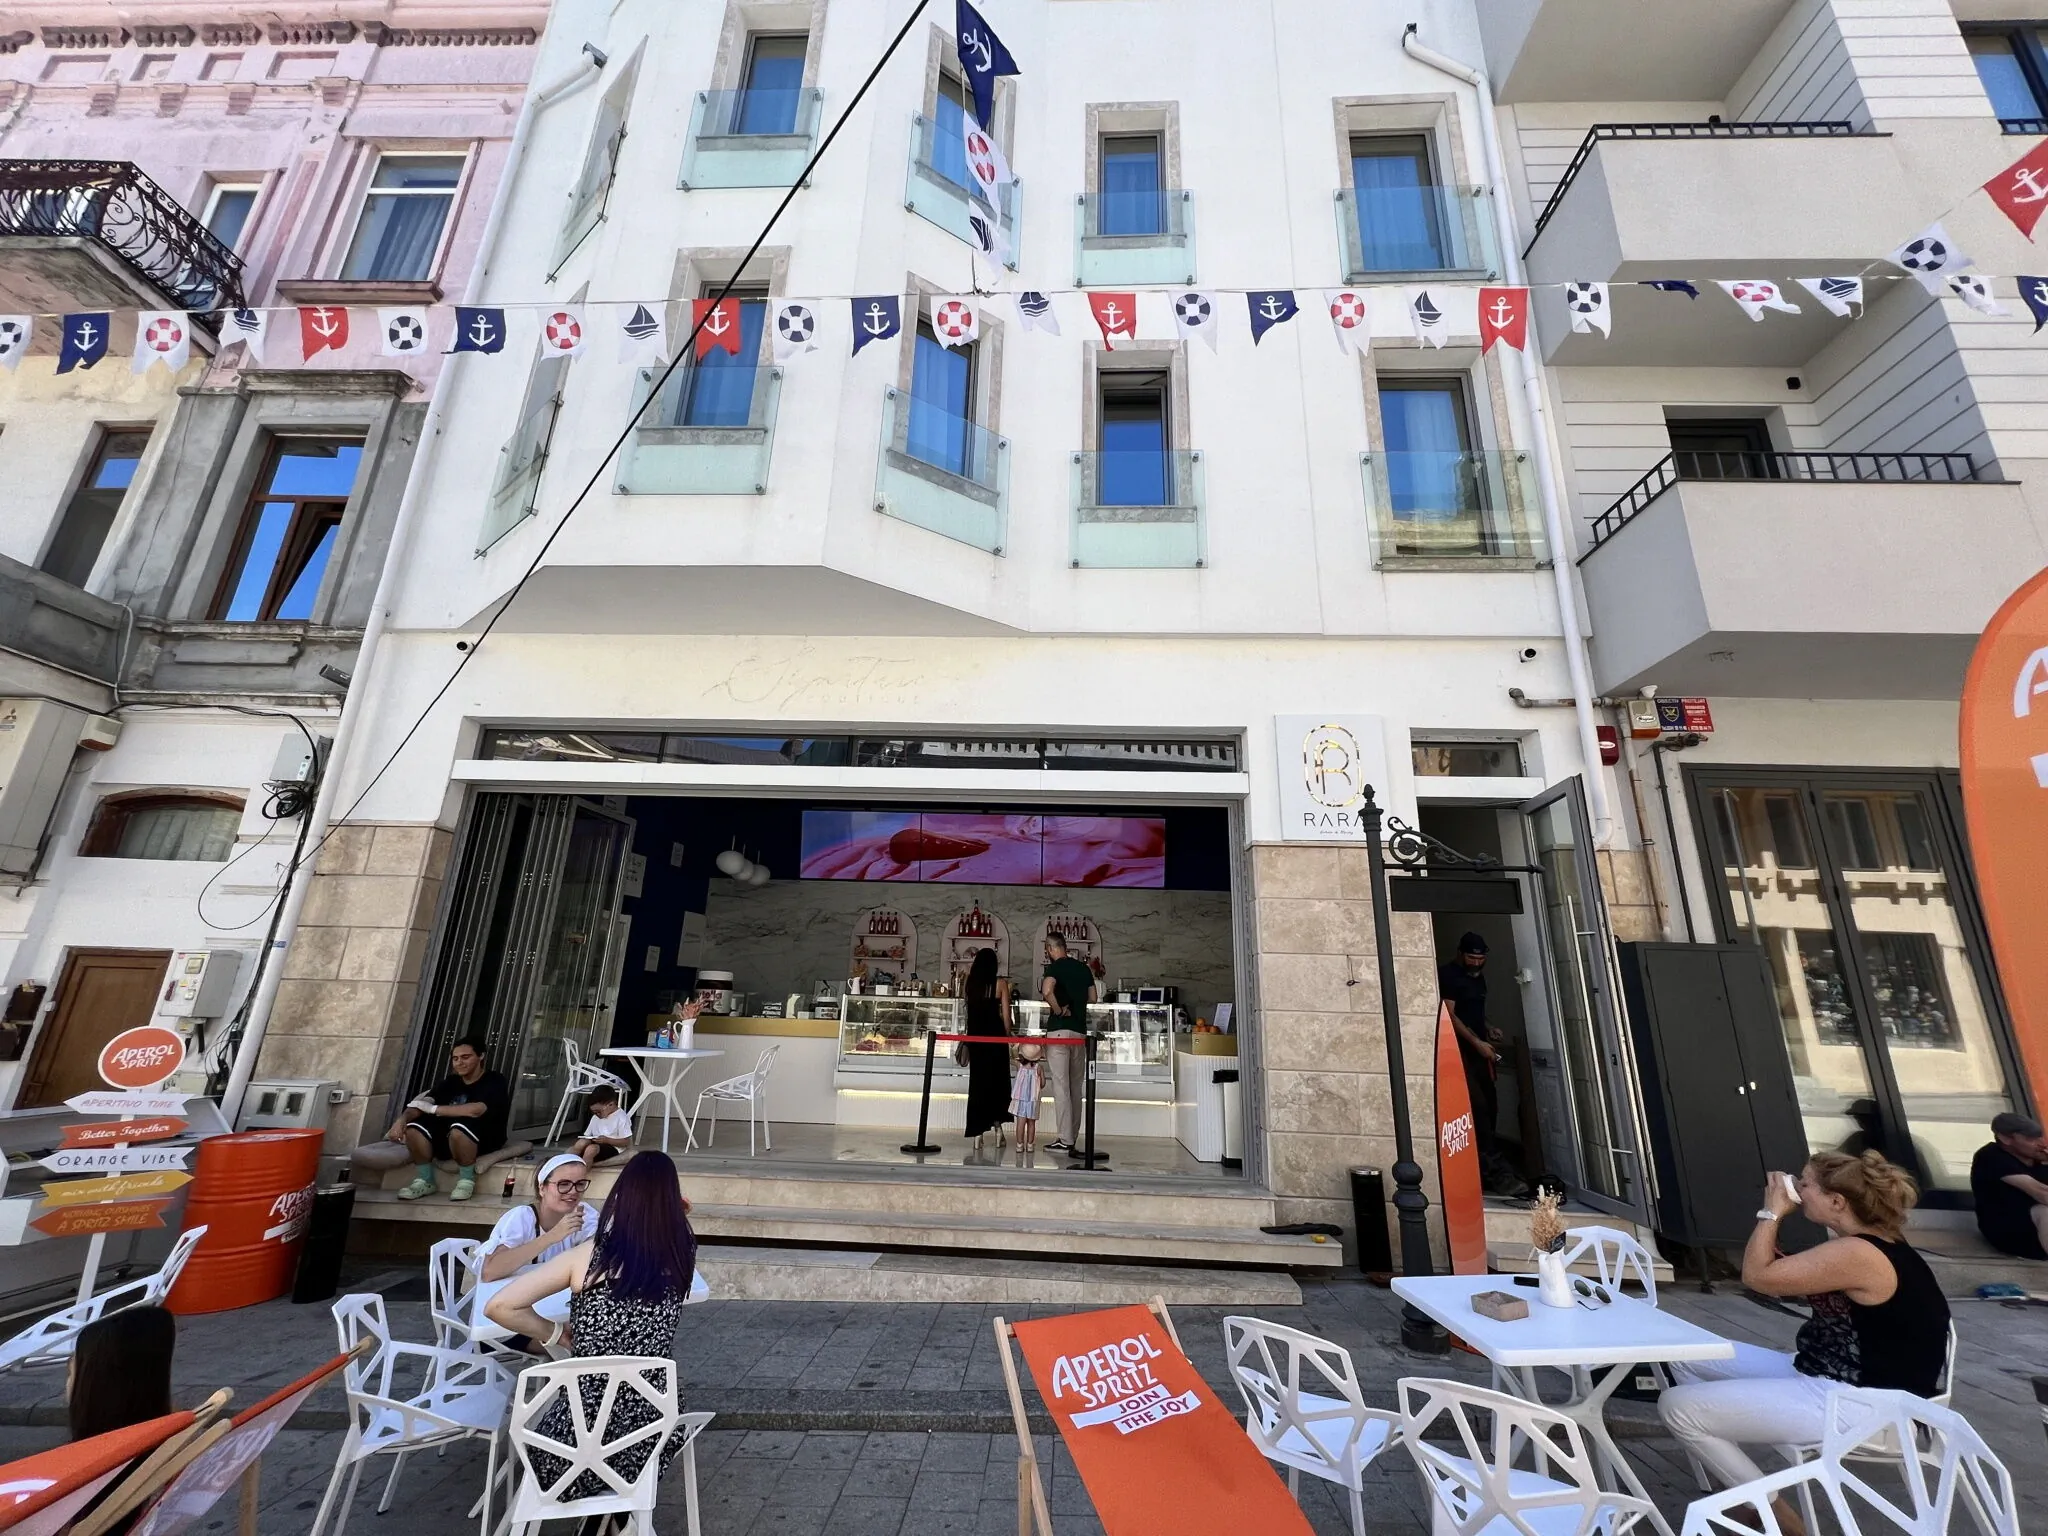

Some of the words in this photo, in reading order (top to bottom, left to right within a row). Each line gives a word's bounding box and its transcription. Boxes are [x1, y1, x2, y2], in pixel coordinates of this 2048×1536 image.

[111, 1044, 175, 1064] APEROL
[118, 1056, 164, 1070] SPRITZ
[148, 1100, 176, 1109] TIME
[78, 1130, 117, 1141] Better
[119, 1123, 171, 1137] Together
[1442, 1113, 1472, 1147] APEROL
[57, 1155, 130, 1167] ORANGE
[141, 1153, 177, 1165] VIBE
[115, 1212, 149, 1227] SMILE
[1052, 1335, 1162, 1398] APEROL
[1118, 1390, 1161, 1414] JOIN
[1120, 1411, 1157, 1429] THE
[1159, 1397, 1190, 1416] JOY
